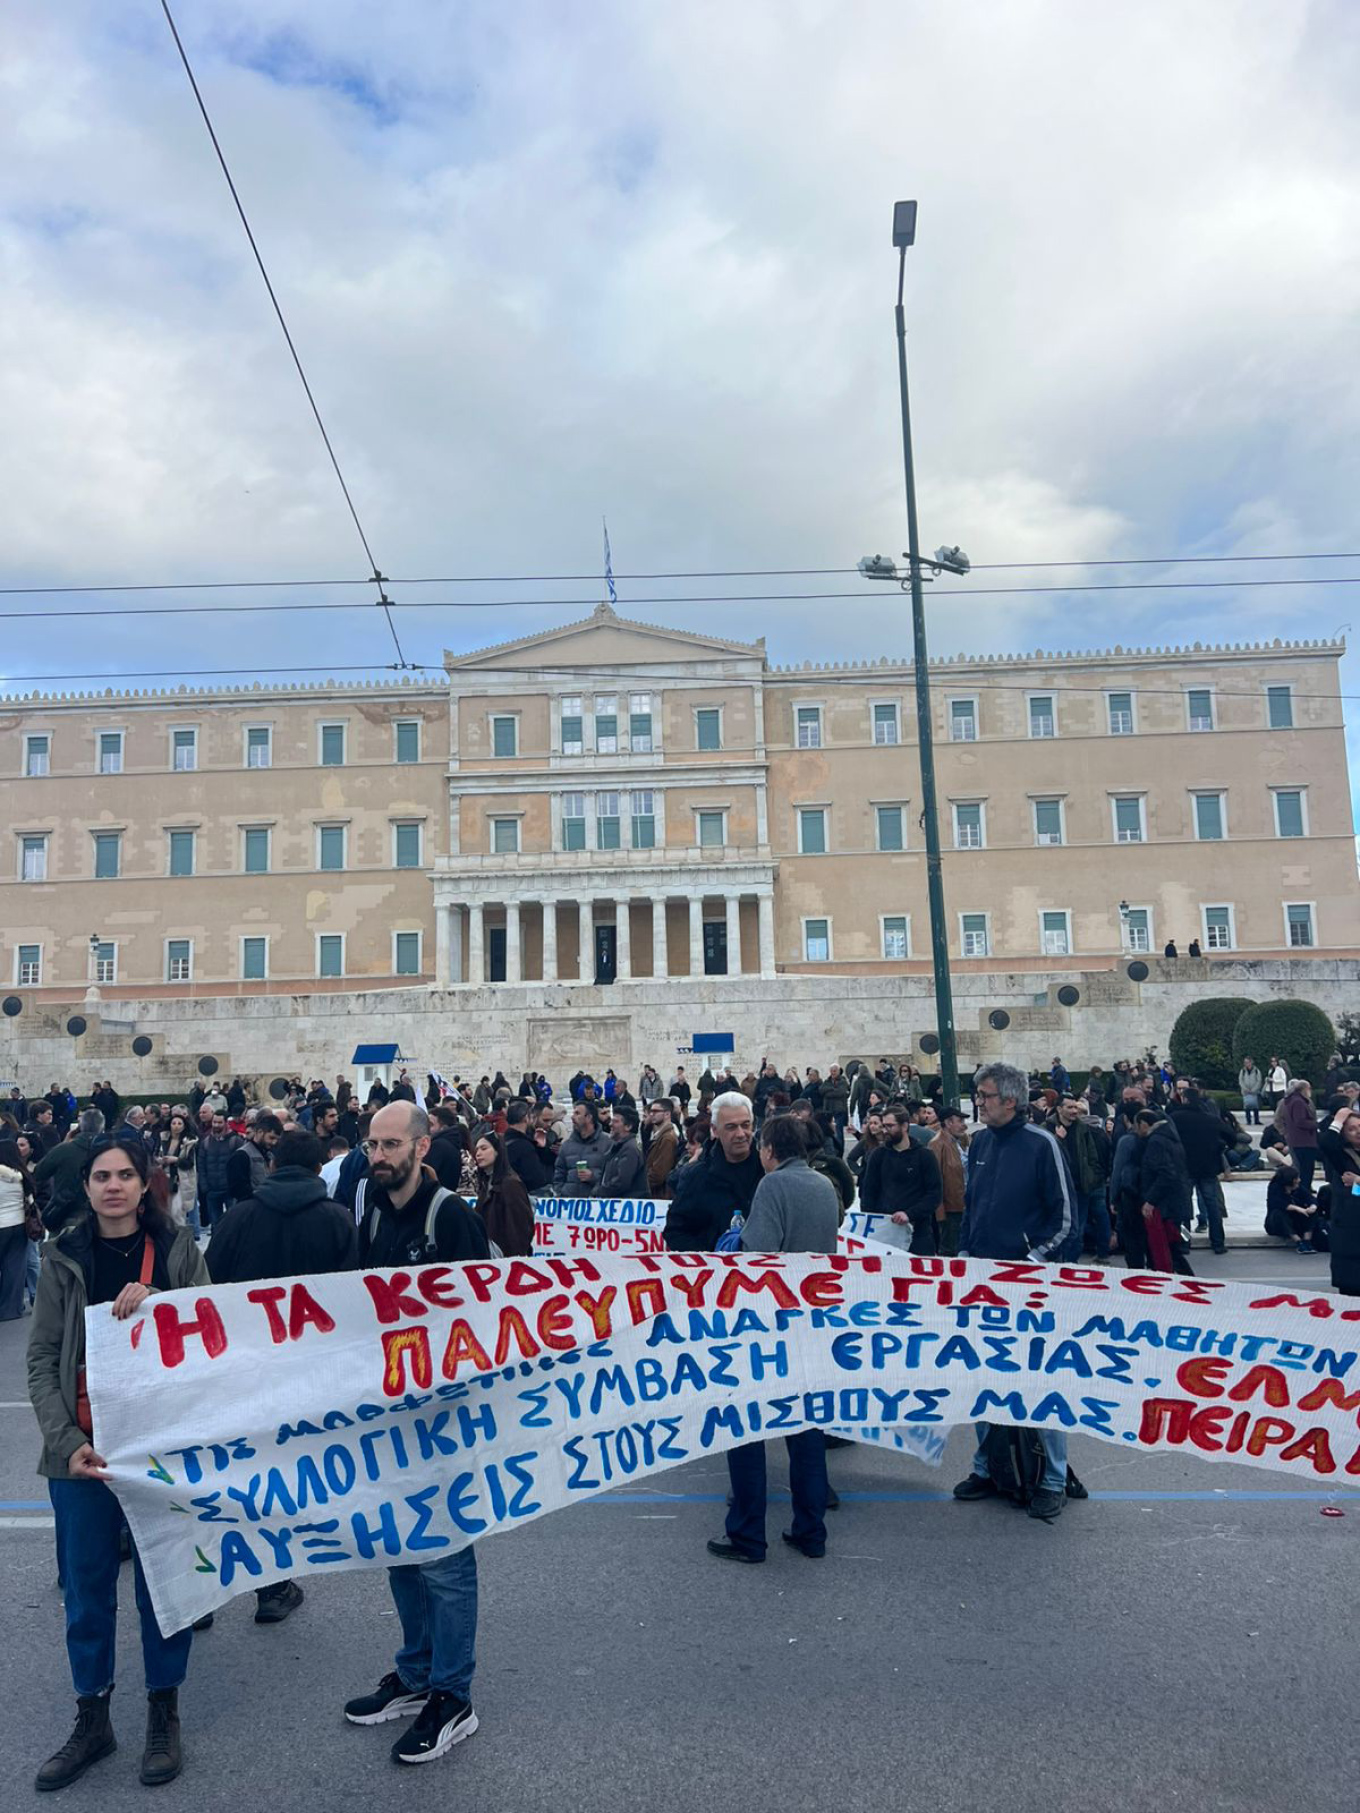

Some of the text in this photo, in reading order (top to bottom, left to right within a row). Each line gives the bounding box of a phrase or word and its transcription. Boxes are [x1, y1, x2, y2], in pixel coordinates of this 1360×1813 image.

[164, 1436, 257, 1485] ΤΙΣ
[645, 1300, 924, 1348] ΑΝΑΓΚΕΣ
[946, 1304, 1057, 1334] ΤΩΝ
[1071, 1314, 1359, 1379] ΜΑΘΗΤΩΝ
[246, 1283, 336, 1344] ΤΑ
[362, 1257, 600, 1324] ΚΕΡΔΗ
[909, 1257, 967, 1278] ΟΙ
[989, 1261, 1226, 1305] ΖΩΕΣ
[189, 1402, 499, 1524] ΣΥΛΛΟΓΙΚΗ
[516, 1339, 790, 1430] ΣΥΜΒΑΣΗ
[219, 1451, 542, 1588] ΑΥΞΗΣΕΙΣ
[562, 1415, 690, 1491] ΣΤΟΥΣ
[699, 1387, 952, 1449] ΜΙΣΘΟΥΣ
